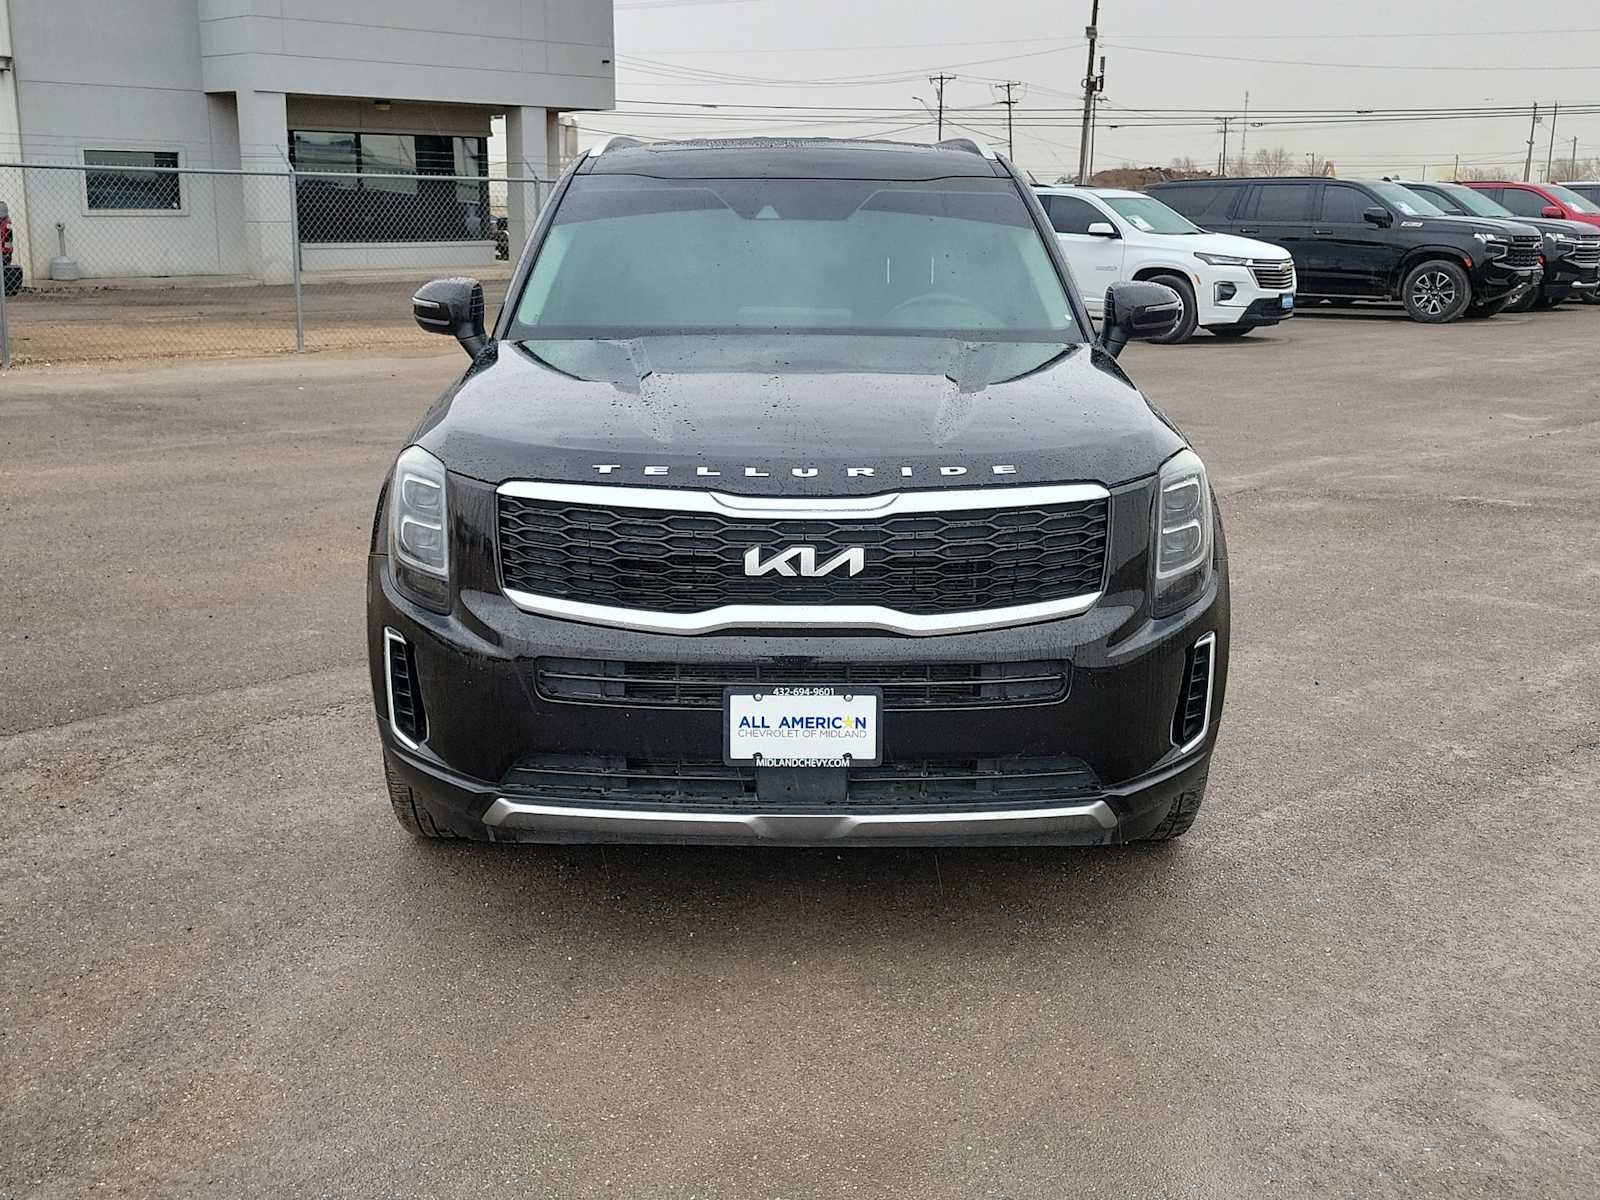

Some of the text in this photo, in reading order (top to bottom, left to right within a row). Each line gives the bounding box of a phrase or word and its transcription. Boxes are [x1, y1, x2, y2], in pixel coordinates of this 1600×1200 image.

[592, 464, 1018, 478] TELLURIDE
[743, 545, 865, 577] KIA
[772, 687, 835, 696] 432-694-9601
[738, 715, 770, 729] ALL
[737, 728, 867, 739] CHEVROLET OF MIDLAND
[755, 758, 850, 768] MIDLANDCHEVY.COM
